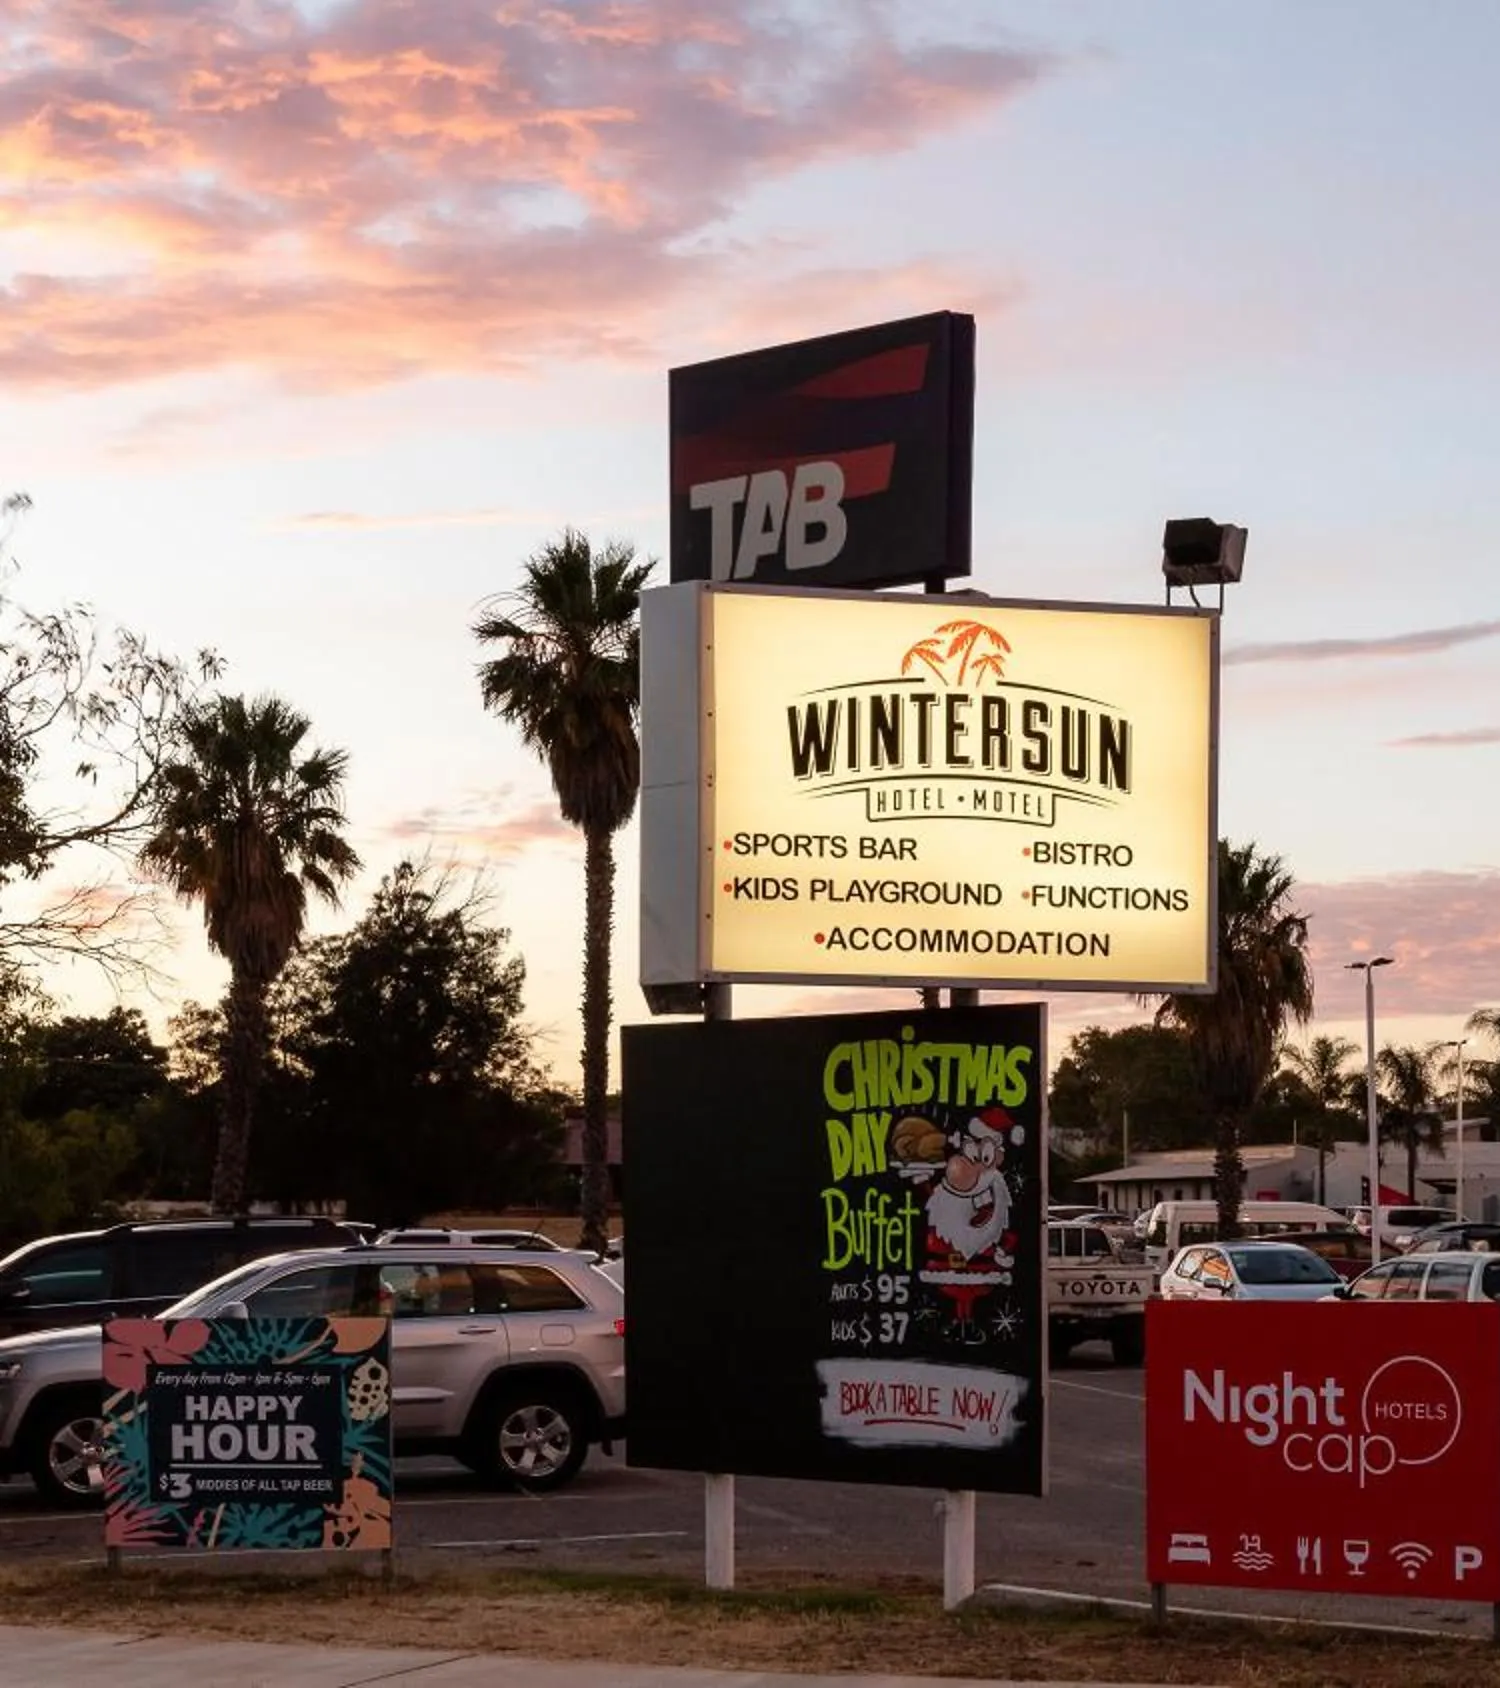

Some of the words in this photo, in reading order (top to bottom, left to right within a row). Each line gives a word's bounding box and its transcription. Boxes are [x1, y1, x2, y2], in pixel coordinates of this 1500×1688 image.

[689, 460, 847, 582] TAB
[787, 692, 1132, 795] WINTERSUN
[876, 787, 945, 812] HOTEL
[973, 789, 1045, 818] MOTEL
[733, 832, 848, 858] SPORTS
[858, 837, 918, 860] BAR
[1033, 841, 1133, 867] BISTRO
[733, 877, 799, 901] KIDS
[810, 879, 1002, 905] PLAYGROUND
[1031, 883, 1189, 911] FUNCTIONS
[826, 926, 1110, 957] ACCOMMODATION
[826, 1111, 893, 1182] DAY
[821, 1187, 920, 1271] Buffet
[1057, 1281, 1141, 1297] TOYOTA
[185, 1395, 303, 1421] HAPPY
[888, 1384, 940, 1416] TABLE
[1183, 1369, 1346, 1446] Night
[1375, 1402, 1447, 1420] HOTELS
[171, 1423, 319, 1461] HOUR
[1283, 1432, 1396, 1489] cap
[196, 1479, 239, 1492] MIDDIES
[241, 1479, 254, 1492] OF
[257, 1479, 278, 1492] ALL
[281, 1480, 300, 1491] TAP
[303, 1480, 333, 1492] BEER
